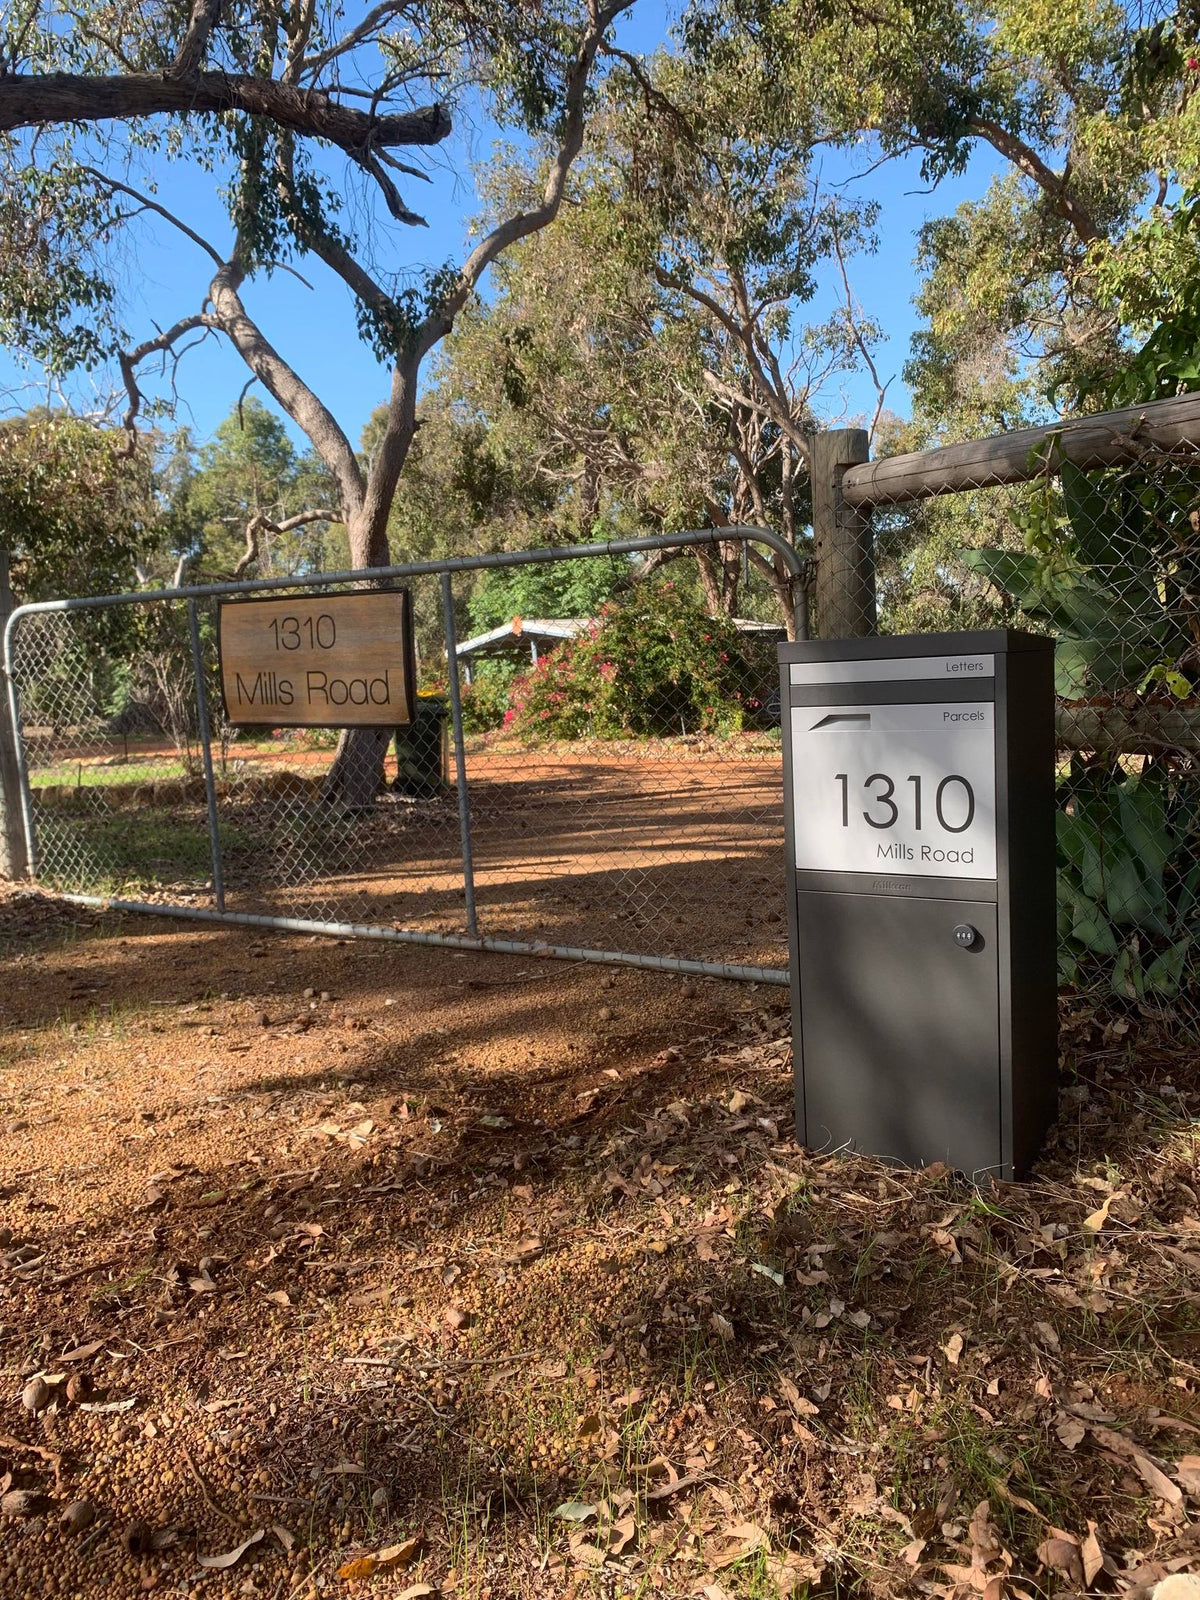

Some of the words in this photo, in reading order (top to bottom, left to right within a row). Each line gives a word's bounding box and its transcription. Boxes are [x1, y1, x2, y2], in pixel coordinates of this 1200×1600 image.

[268, 614, 337, 651] 1310
[945, 661, 984, 673] Letters
[235, 671, 295, 706] Mills
[306, 669, 391, 706] Road
[942, 710, 985, 722] Parcels
[834, 773, 976, 834] 1310
[876, 843, 914, 861] Mills
[920, 845, 975, 864] Road
